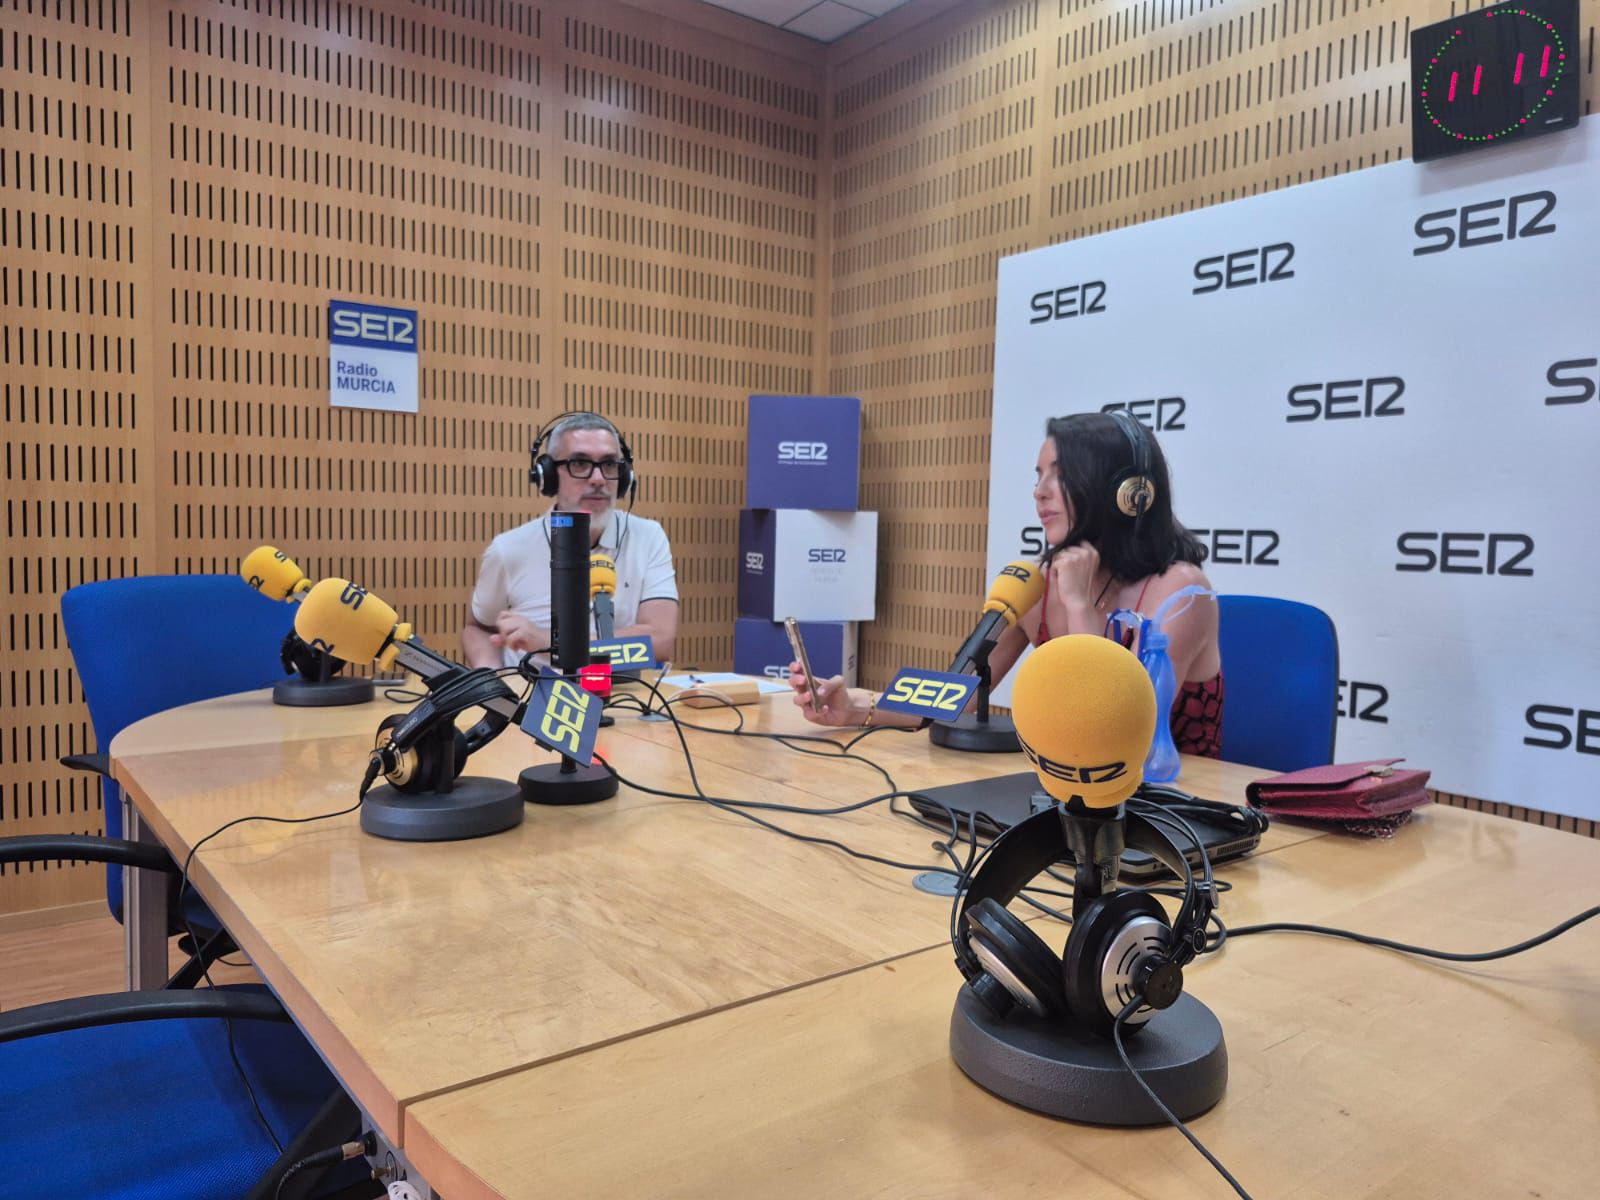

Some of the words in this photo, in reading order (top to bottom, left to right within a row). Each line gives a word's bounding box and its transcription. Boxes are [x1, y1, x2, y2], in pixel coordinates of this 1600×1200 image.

[1413, 190, 1557, 257] SER
[1193, 242, 1295, 296] SER
[1030, 280, 1107, 325] SER
[333, 309, 414, 344] SER
[336, 361, 378, 377] Radio
[336, 376, 396, 395] MURCIA
[1101, 397, 1186, 432] ER
[1286, 376, 1405, 423] SER
[778, 441, 828, 460] SER
[808, 548, 846, 563] SER
[1396, 532, 1534, 577] SER
[1000, 565, 1031, 583] ER
[590, 642, 650, 665] ER
[763, 665, 791, 679] SE
[886, 677, 967, 711] SER
[541, 680, 590, 753] SER
[1523, 703, 1600, 756] SE
